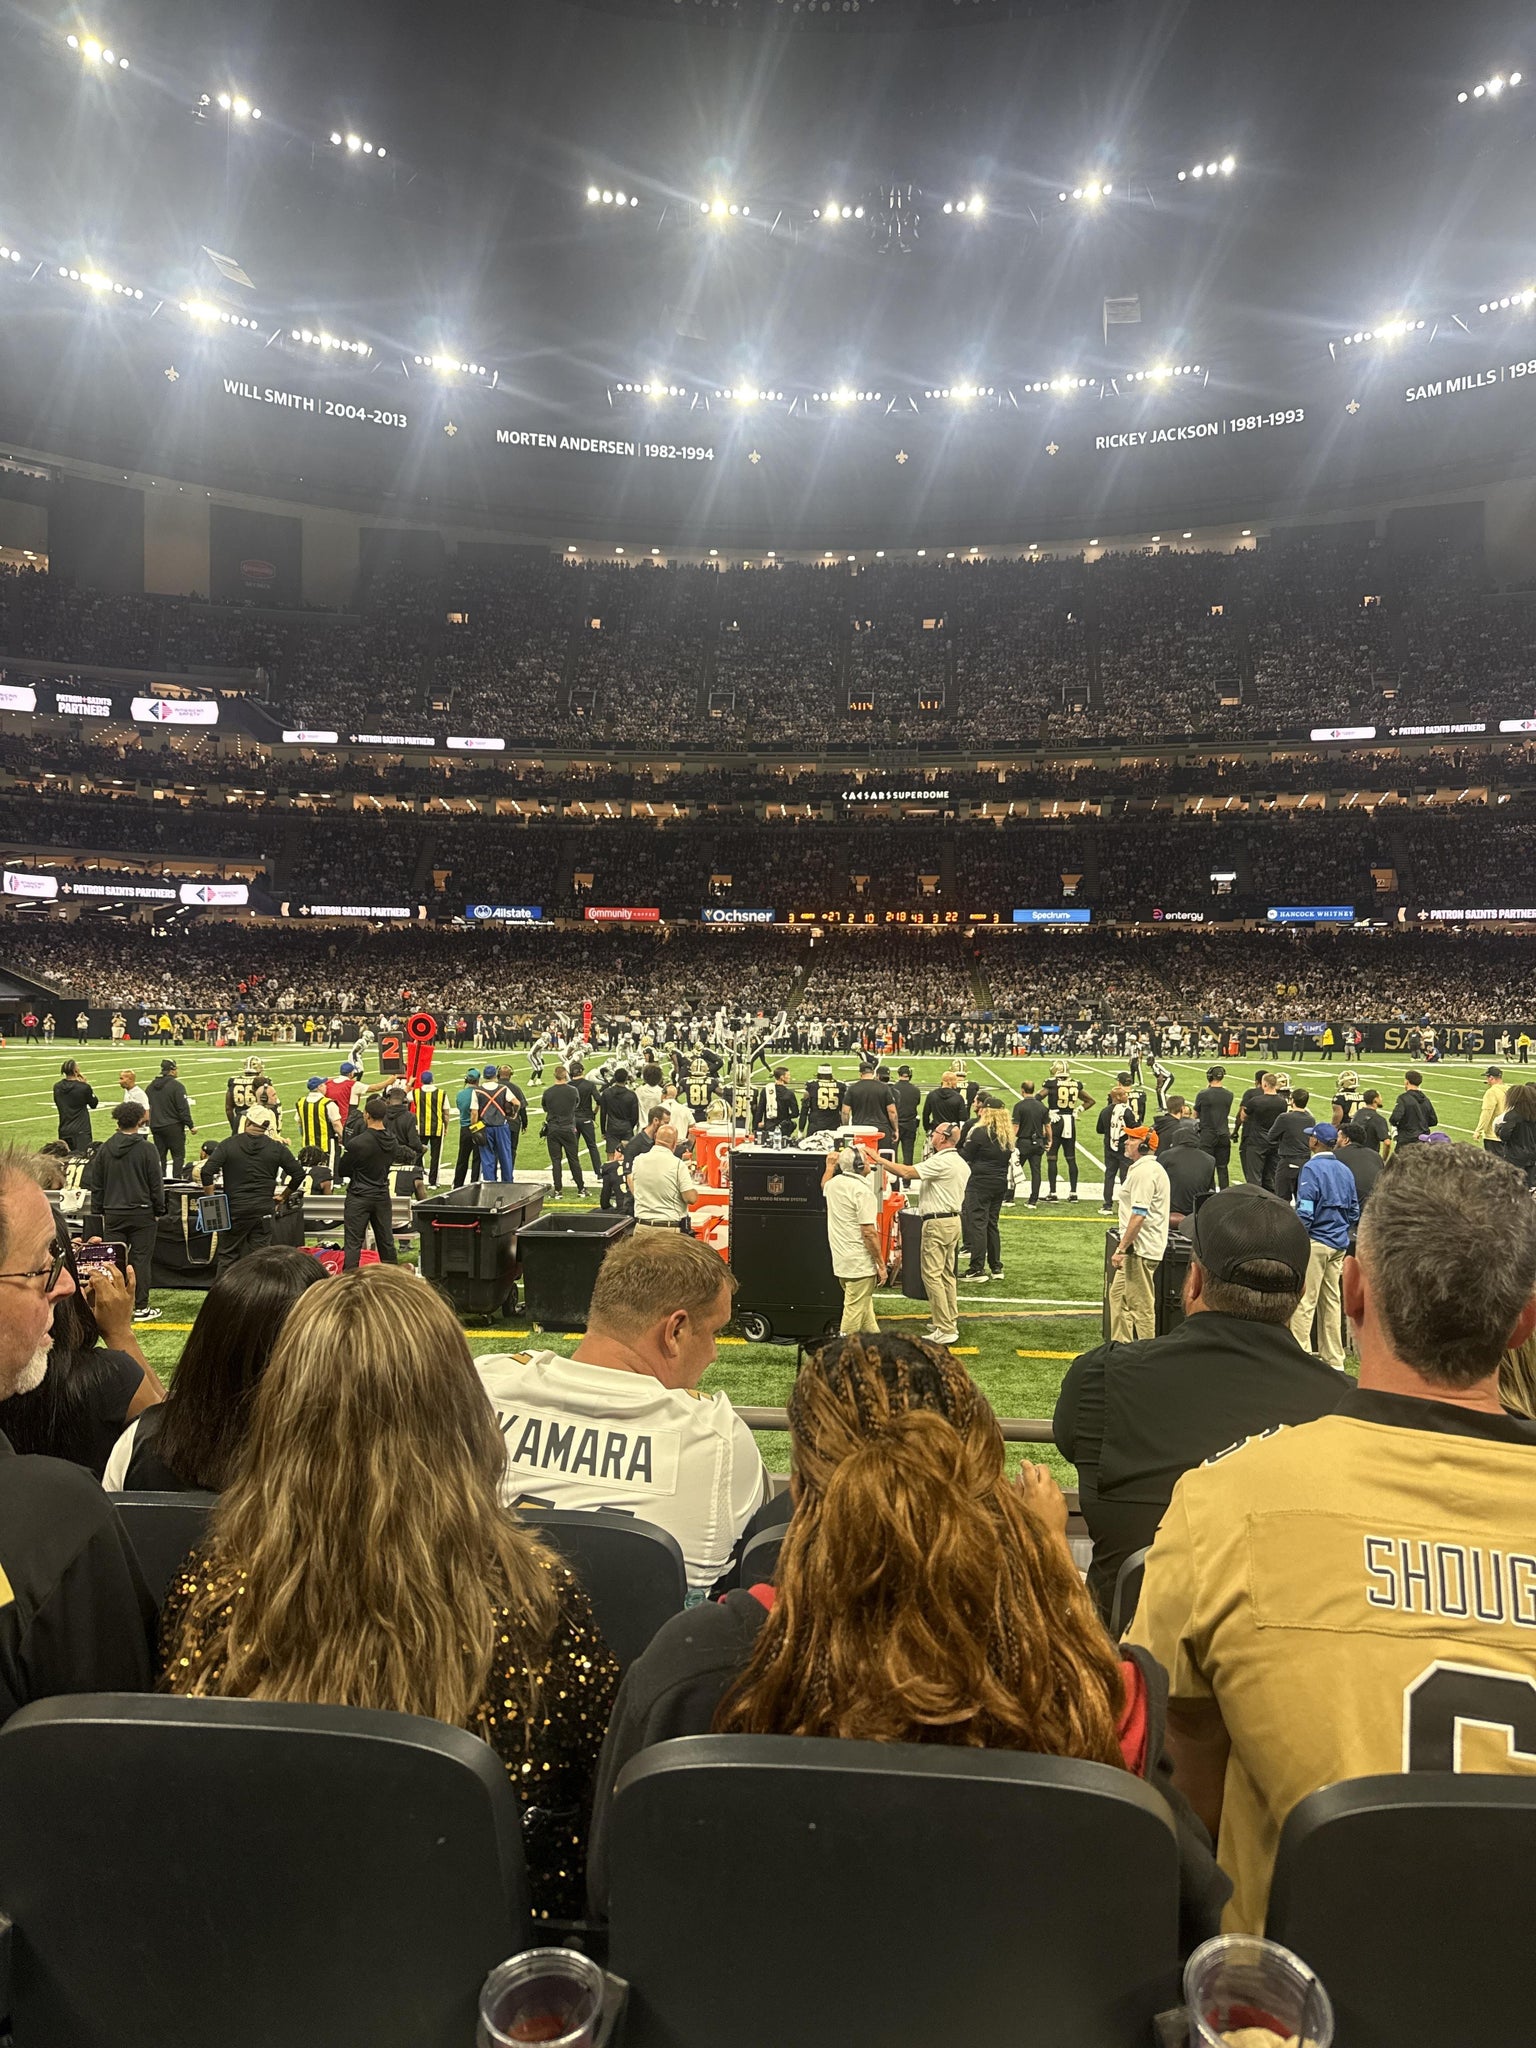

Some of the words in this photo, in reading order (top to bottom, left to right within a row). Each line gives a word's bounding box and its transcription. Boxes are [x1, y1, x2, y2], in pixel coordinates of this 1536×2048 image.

[1405, 382, 1442, 402] SAM
[1446, 370, 1497, 394] MILLS
[1508, 360, 1536, 379] 198
[223, 378, 262, 401] WILL
[264, 388, 314, 412] SMITH
[325, 401, 408, 428] 2004-2013
[1095, 432, 1148, 450] RICKEY
[1149, 421, 1219, 444] JACKSON
[1229, 408, 1305, 433] 1981-1993
[496, 429, 557, 448] MORTEN
[559, 436, 635, 456] ANDERSEN
[644, 443, 715, 461] 1982-1994
[58, 702, 110, 718] PARTNERS
[1398, 726, 1425, 736] PATRON
[1451, 723, 1486, 733] PARTNERS
[635, 741, 671, 752] SAINTS
[714, 743, 749, 753] SAINTS
[792, 743, 827, 753] SAINTS
[1041, 738, 1078, 749] SAINTS
[842, 791, 892, 801] CAESARS
[892, 790, 950, 800] SUPERDOME
[73, 884, 105, 896] PATRON
[105, 886, 135, 897] SAINTS
[135, 888, 177, 899] PARTNERS
[310, 906, 342, 916] PATRON
[342, 907, 371, 917] SAINTS
[371, 908, 411, 918] PARTNERS
[588, 907, 632, 920] Community
[712, 909, 772, 922] Ochsner
[788, 913, 796, 924] 3
[827, 912, 841, 922] 27
[848, 914, 855, 924] 2
[864, 914, 875, 924] 10
[910, 914, 924, 924] 43
[932, 914, 940, 924] 3
[944, 911, 959, 922] 22
[992, 914, 1000, 924] 3
[1032, 910, 1068, 921] Spectrum
[1165, 912, 1204, 922] entergy
[1279, 910, 1315, 918] HANCOCK
[1317, 910, 1354, 918] WHITNEY
[1430, 909, 1464, 920] PATRON
[1465, 909, 1498, 919] SAINTS
[381, 1036, 401, 1060] 2
[233, 1084, 257, 1107] 66
[689, 1084, 709, 1106] 81
[817, 1087, 840, 1110] 65
[1057, 1086, 1079, 1109] 93
[1362, 1533, 1536, 1631] SHOUG
